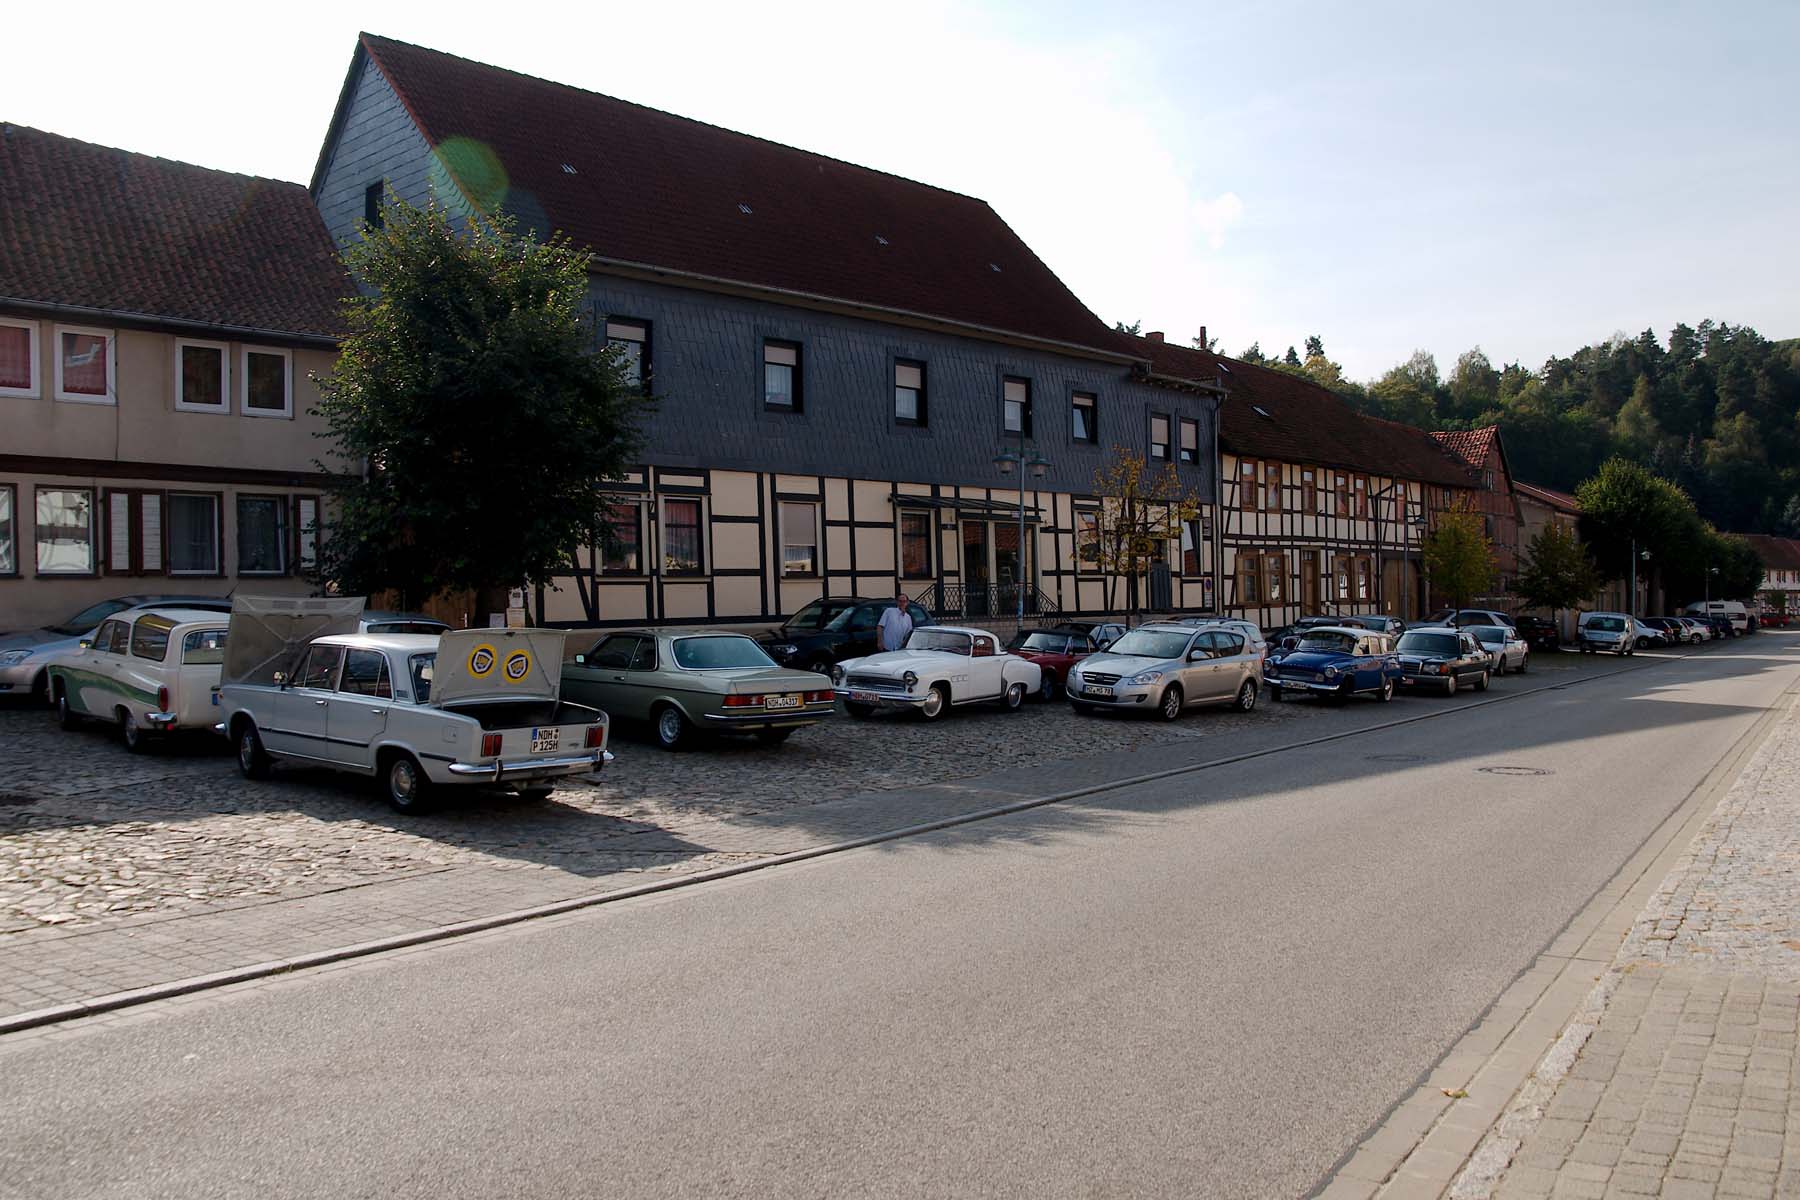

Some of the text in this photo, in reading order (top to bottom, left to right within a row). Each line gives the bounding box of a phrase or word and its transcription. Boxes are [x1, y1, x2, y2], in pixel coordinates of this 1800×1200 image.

[539, 730, 552, 739] NDH
[533, 740, 558, 751] P 125H
